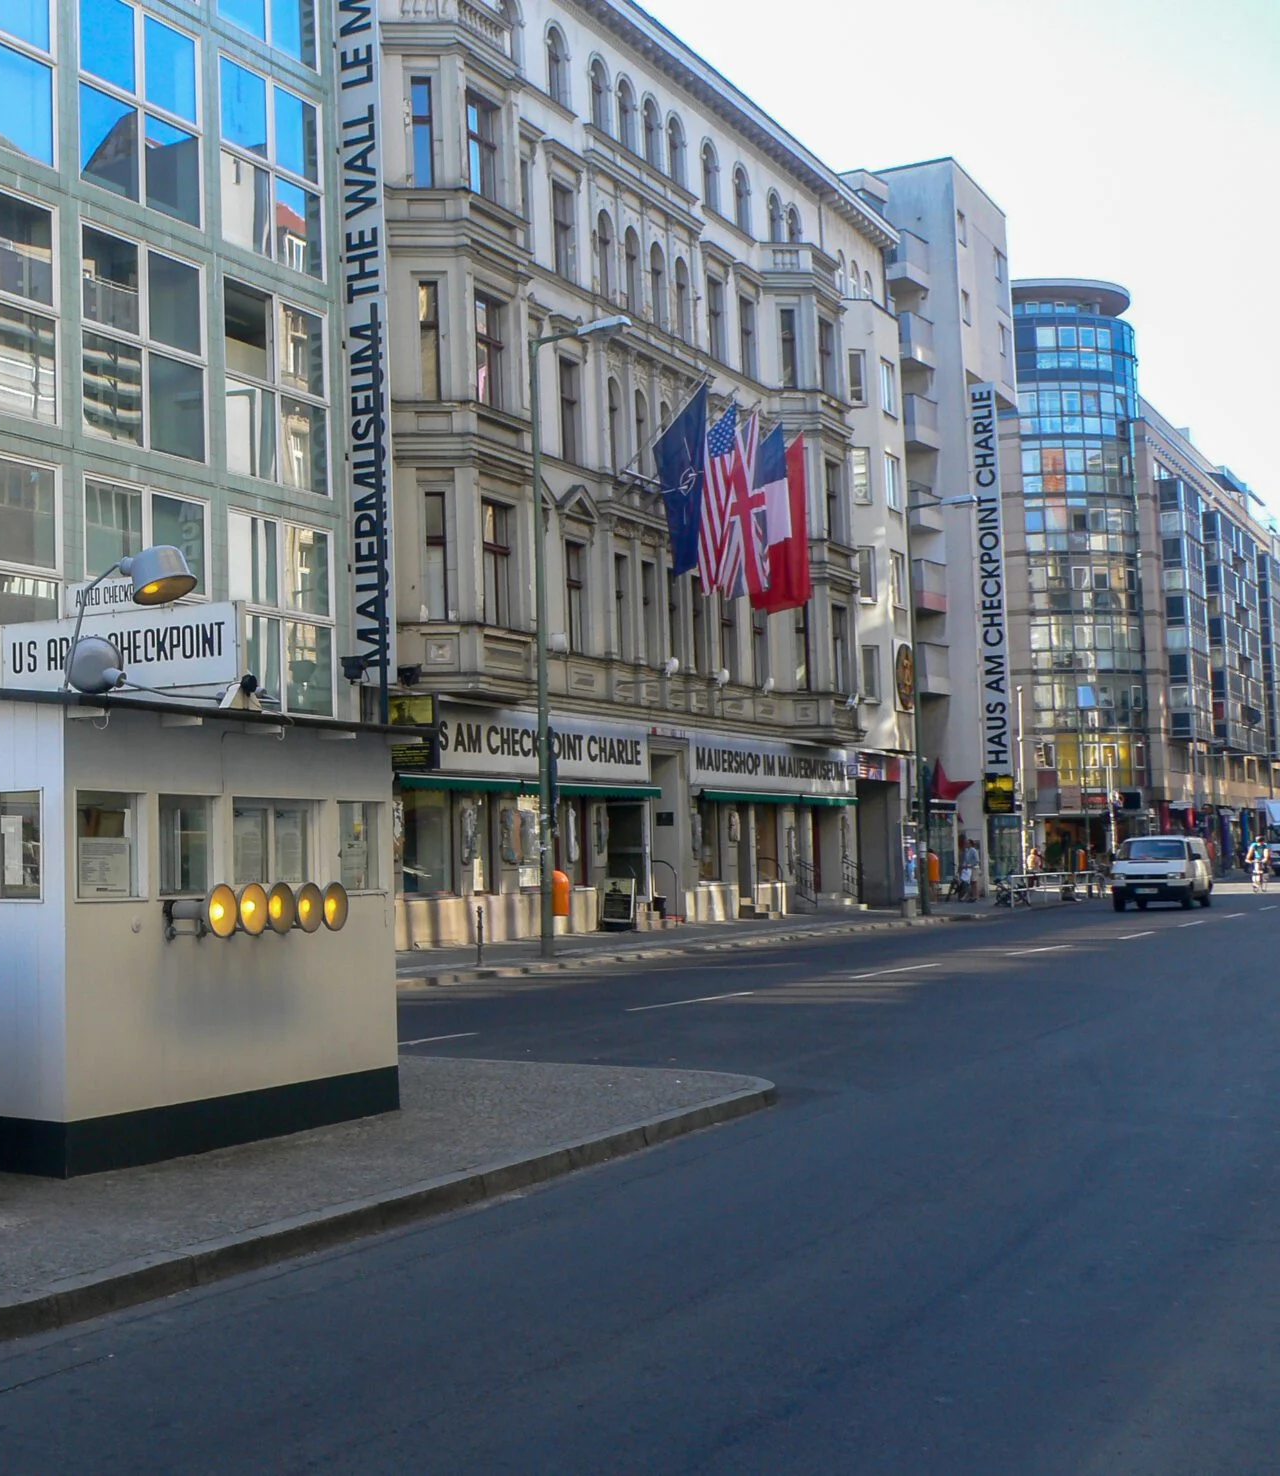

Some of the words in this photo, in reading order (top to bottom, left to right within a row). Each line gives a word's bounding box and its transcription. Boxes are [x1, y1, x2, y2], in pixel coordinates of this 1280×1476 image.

[340, 43, 373, 90] LE
[342, 103, 377, 222] WALL
[346, 226, 380, 305] THE
[971, 389, 996, 488] CHARLIE
[349, 320, 390, 668] MAUERMUSEUM
[75, 587, 101, 608] AIED
[977, 496, 1003, 648] CHECKPOINT
[984, 654, 1005, 695] AM
[453, 722, 482, 755] AM
[486, 725, 584, 762] CHECKOINT
[587, 735, 642, 766] CHARLIE
[695, 746, 761, 776] MAUERSHOP
[763, 754, 776, 777] IM
[778, 755, 845, 782] MAUERMUSEUM
[985, 701, 1008, 766] HAUS
